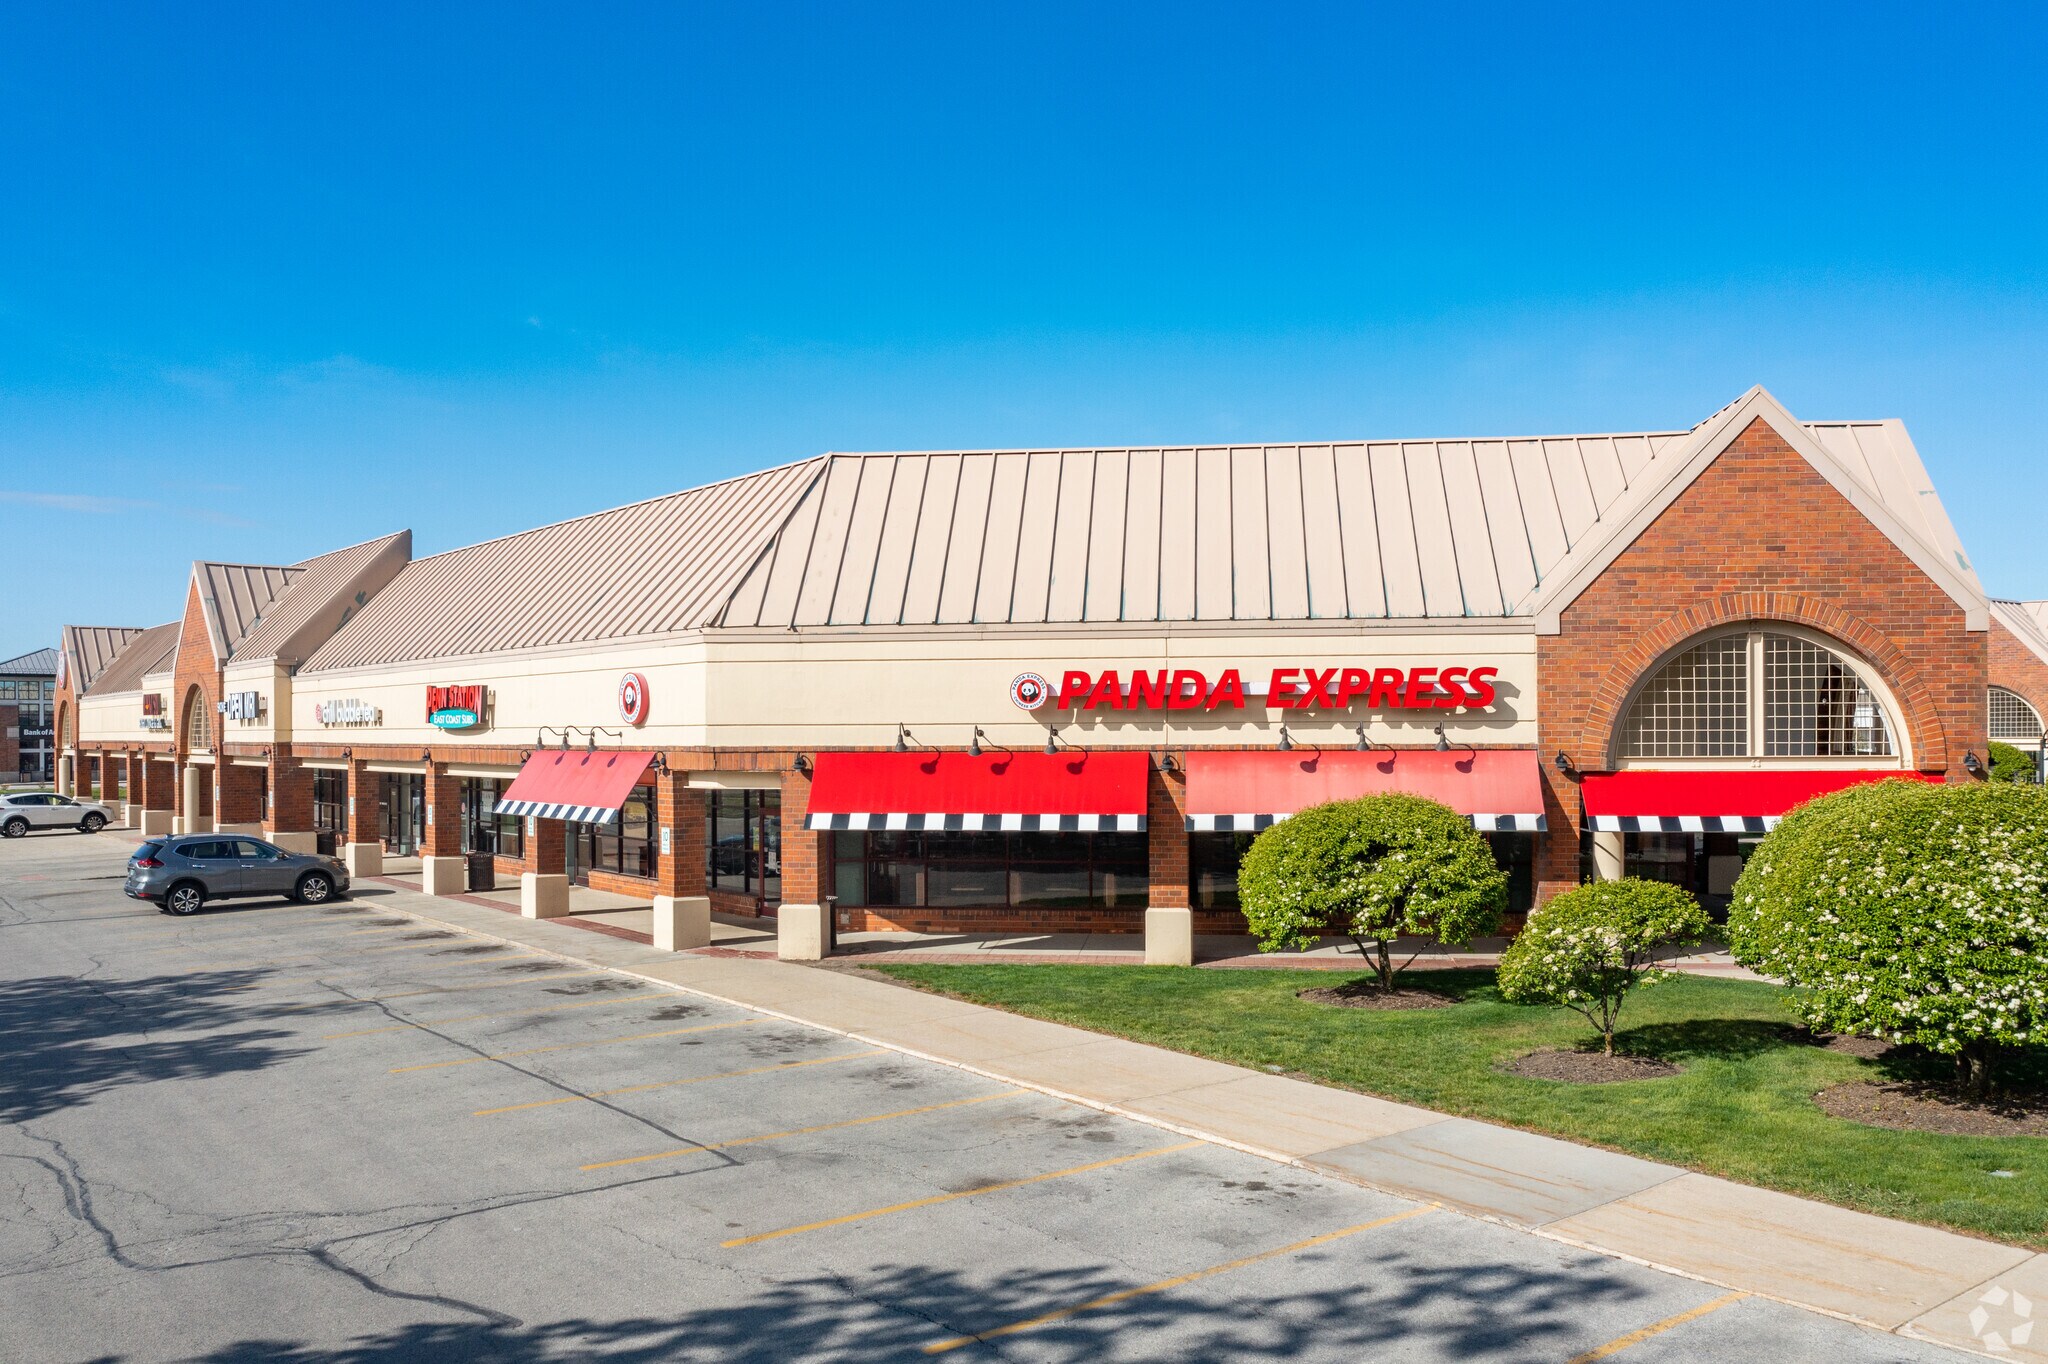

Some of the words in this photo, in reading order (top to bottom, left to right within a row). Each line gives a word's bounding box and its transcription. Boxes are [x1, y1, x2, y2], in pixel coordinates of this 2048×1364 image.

[1012, 675, 1026, 690] PANDA
[1026, 674, 1046, 690] EXPRESS
[1057, 669, 1246, 710] PANDA
[1265, 667, 1499, 709] EXPRESS
[426, 685, 448, 724] PENN
[448, 684, 482, 724] STATION
[445, 714, 461, 724] COAST
[461, 714, 474, 724] SUBS
